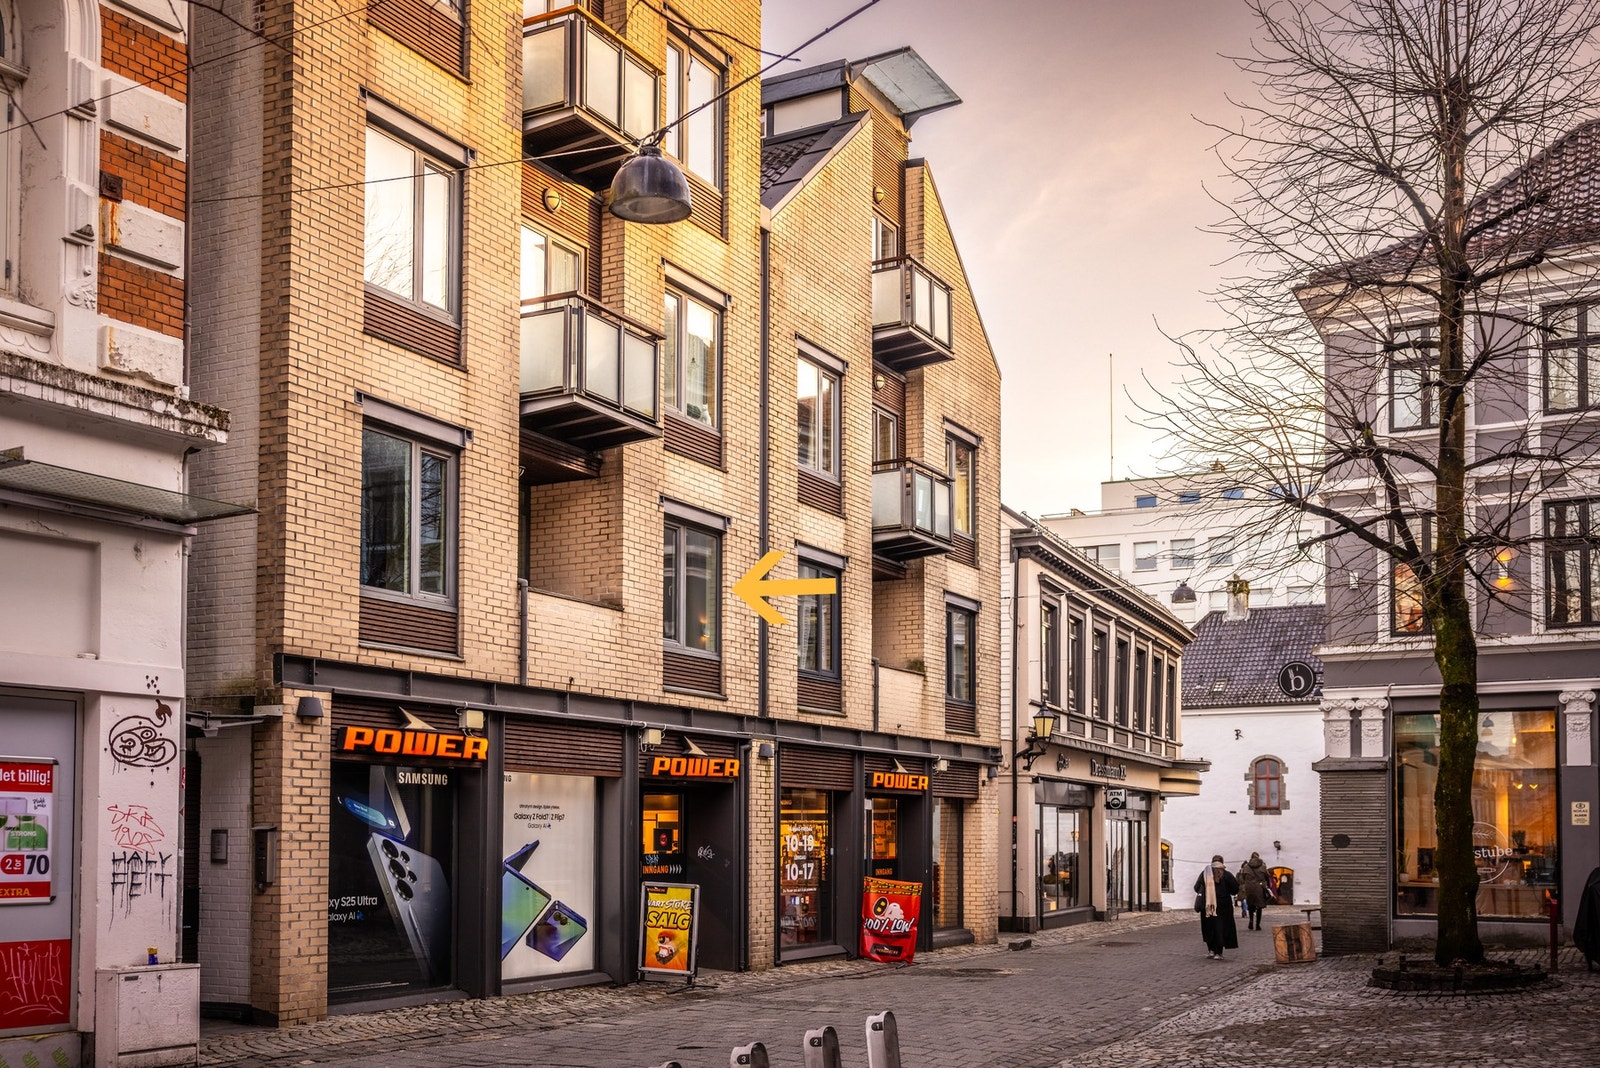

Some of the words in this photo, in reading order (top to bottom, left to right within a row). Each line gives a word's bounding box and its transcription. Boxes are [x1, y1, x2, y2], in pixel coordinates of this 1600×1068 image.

[343, 726, 489, 760] POWER
[652, 756, 740, 777] POWER
[18, 769, 51, 786] billig!
[398, 772, 449, 786] SAMSUNG
[872, 771, 929, 790] POWER
[514, 812, 532, 821] Galaxy
[532, 812, 536, 820] Z
[550, 813, 555, 821] Z
[555, 813, 565, 822] Flip7
[785, 834, 815, 852] 10-19
[1474, 844, 1513, 859] stube
[5, 858, 12, 870] 2
[13, 858, 22, 870] for
[25, 854, 50, 875] 70
[642, 864, 670, 875] INNGANG
[785, 863, 815, 881] 10-17
[341, 896, 356, 907] S25
[357, 895, 378, 906] Ultra
[645, 910, 692, 931] SALG
[890, 917, 915, 933] LOW
[813, 1038, 819, 1046] 2
[741, 1055, 747, 1063] 3
